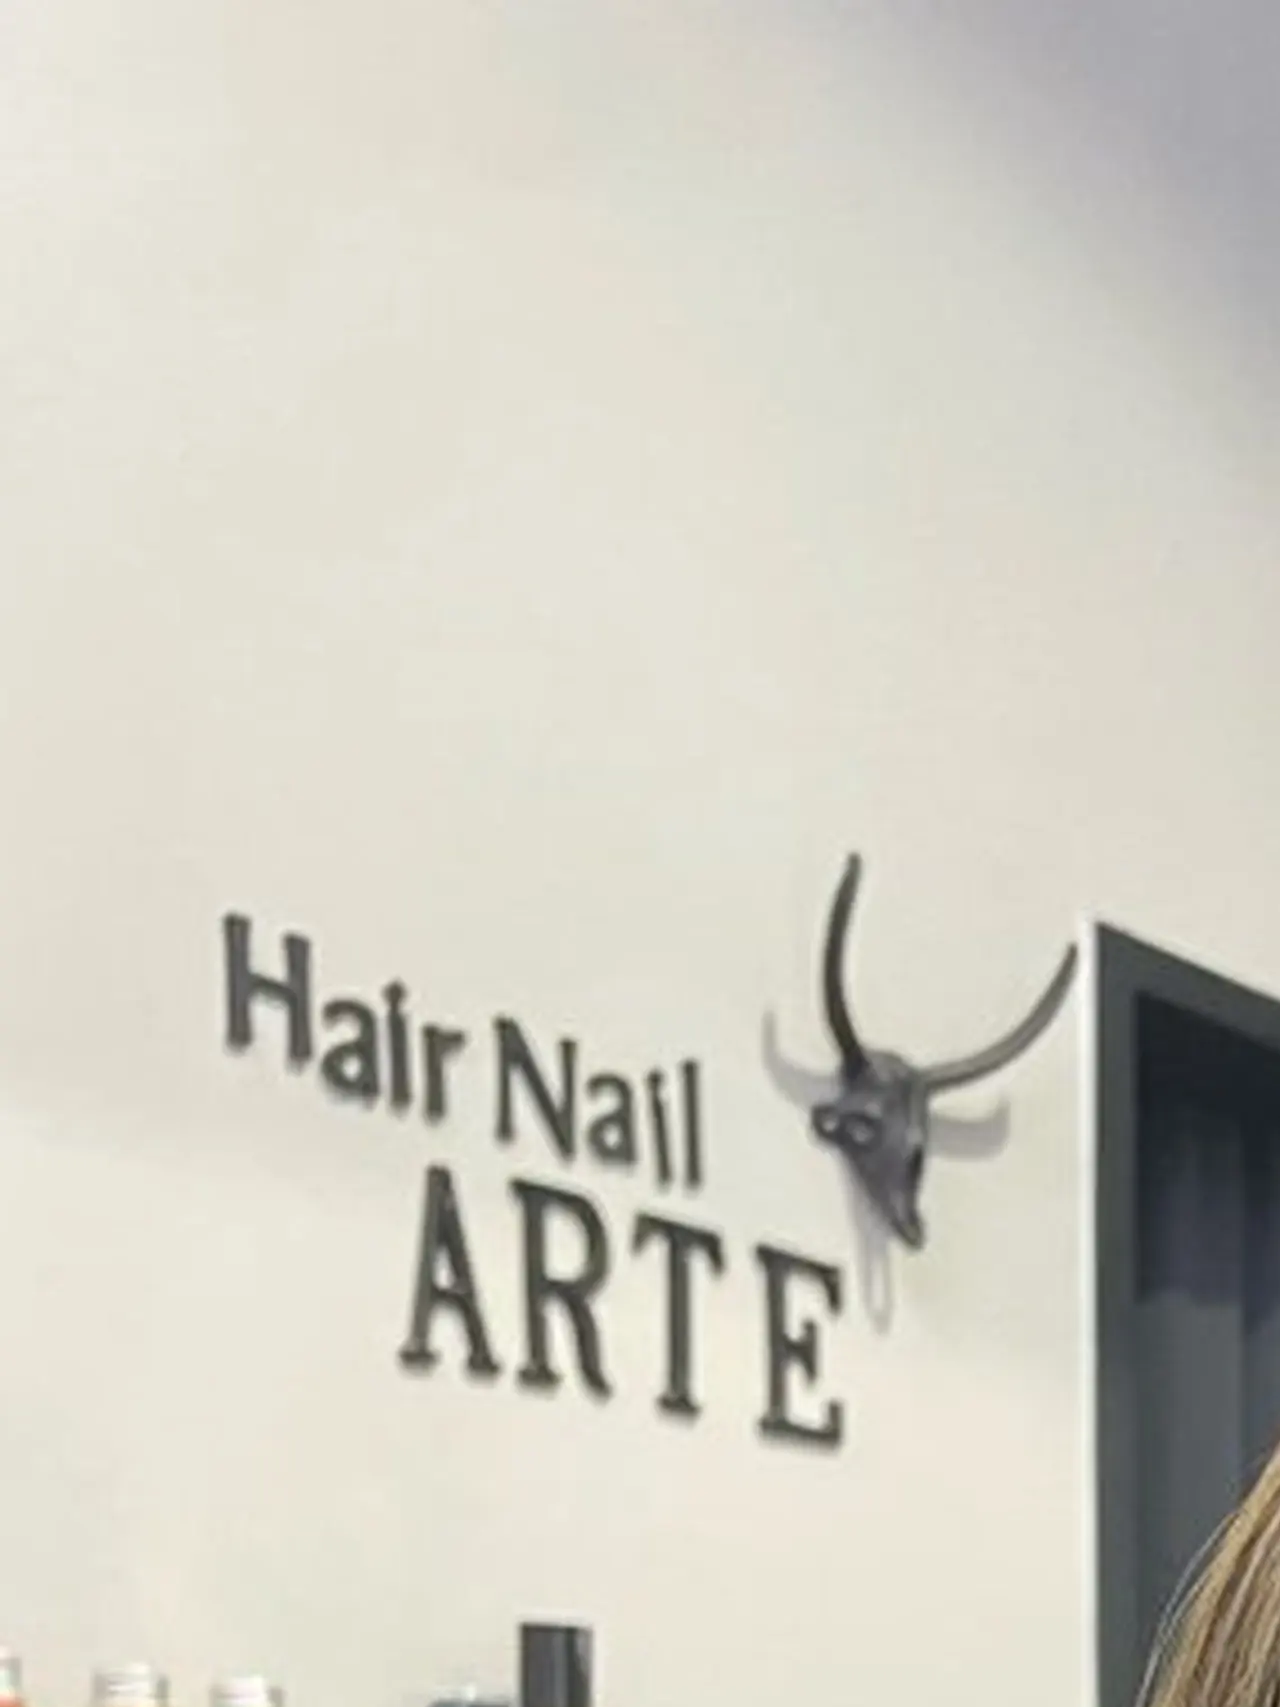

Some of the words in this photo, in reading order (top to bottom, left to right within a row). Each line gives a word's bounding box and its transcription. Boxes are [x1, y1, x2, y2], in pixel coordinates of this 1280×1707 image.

[223, 912, 467, 1123] Hair
[493, 1014, 703, 1191] Nail
[399, 1166, 845, 1452] ARTE
